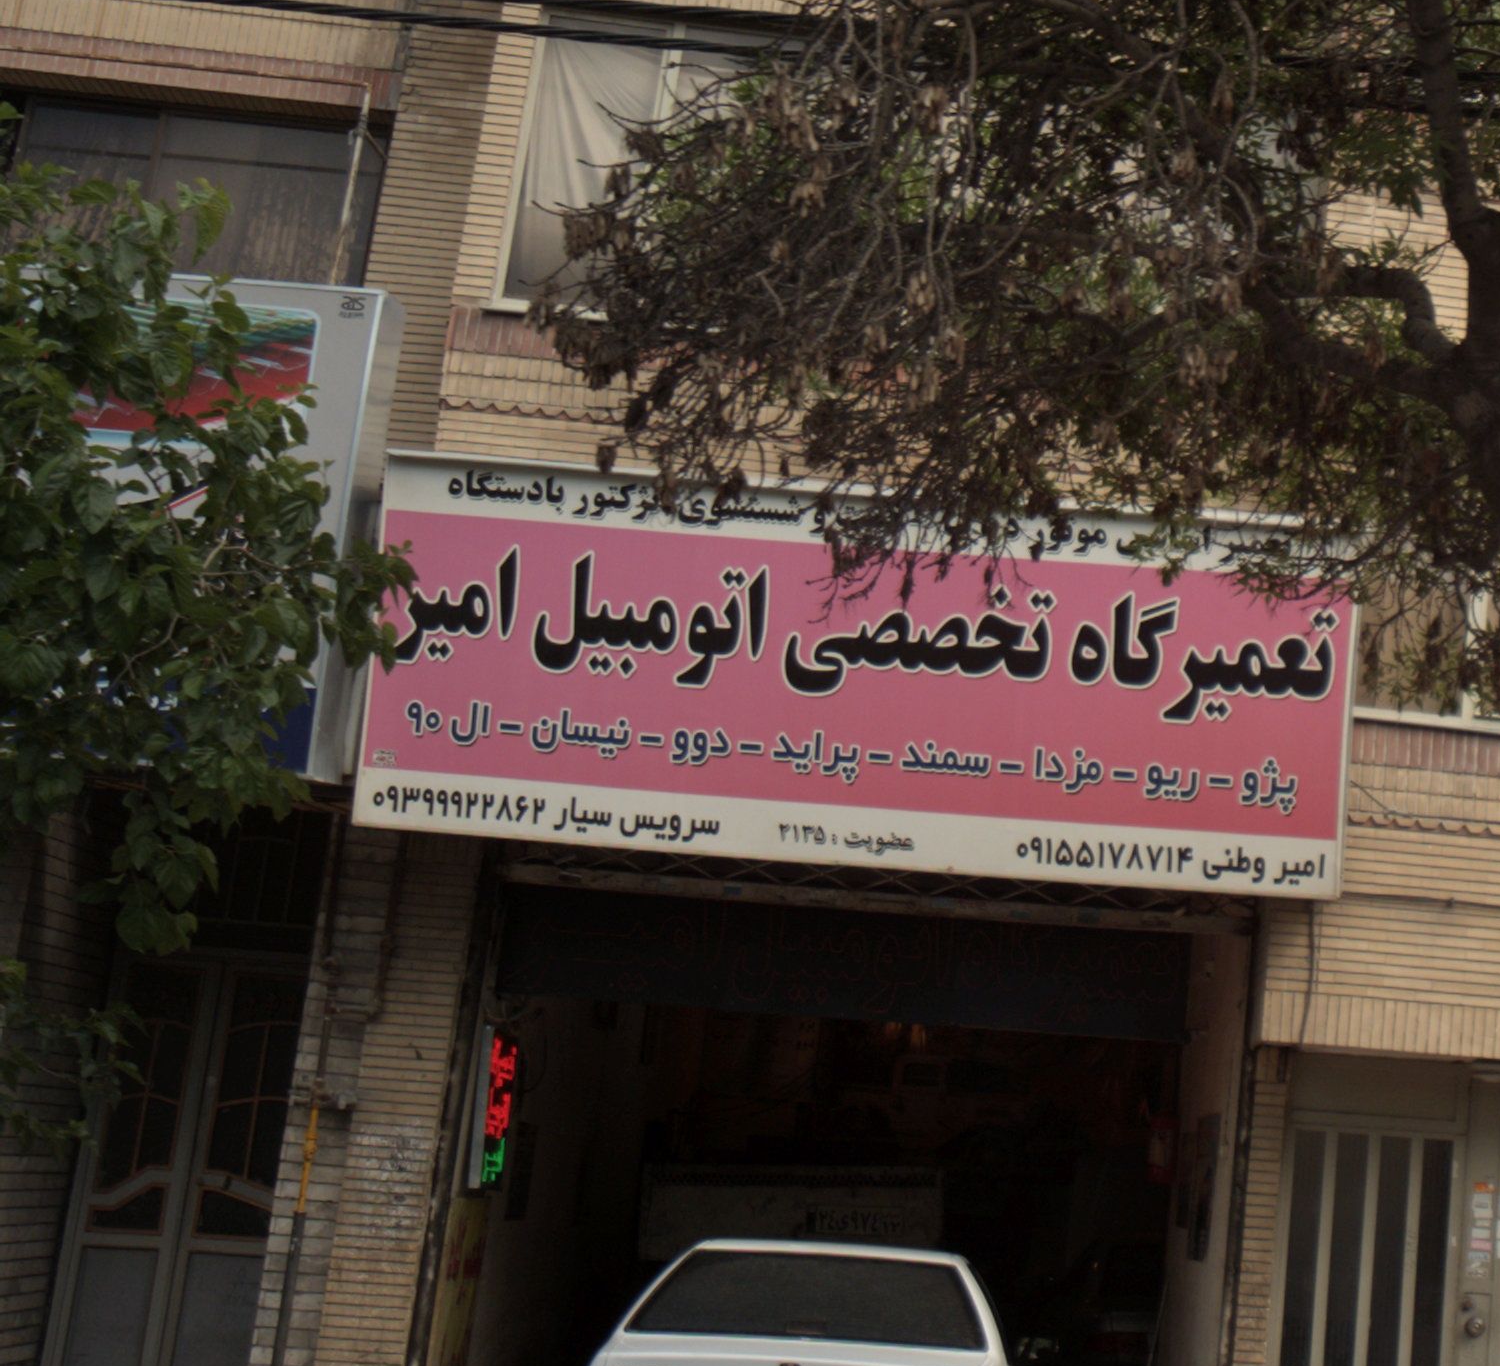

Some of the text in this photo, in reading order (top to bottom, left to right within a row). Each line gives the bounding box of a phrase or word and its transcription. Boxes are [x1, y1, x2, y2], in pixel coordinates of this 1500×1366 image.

[395, 544, 1338, 723] تعمیرگاه تخصصی اتومبیل امیر
[407, 701, 442, 734] ۹۰
[450, 701, 491, 746] ال
[531, 708, 632, 758] نیسان
[671, 728, 731, 765] دوو
[772, 732, 859, 783] پراید
[901, 740, 990, 778] سمند
[1034, 747, 1104, 793] مزدا
[1145, 762, 1198, 800] ریو
[1240, 757, 1298, 813] پژو
[372, 785, 721, 843] سرویس سیار ۰۹۳۹۹۹۲۲۸۶۲
[779, 822, 827, 845] ۲۱۳۵
[843, 832, 915, 855] عضویت
[1016, 836, 1327, 886] امیر وطنی ۰۹۱۵۵۱۷۸۷۱۴
